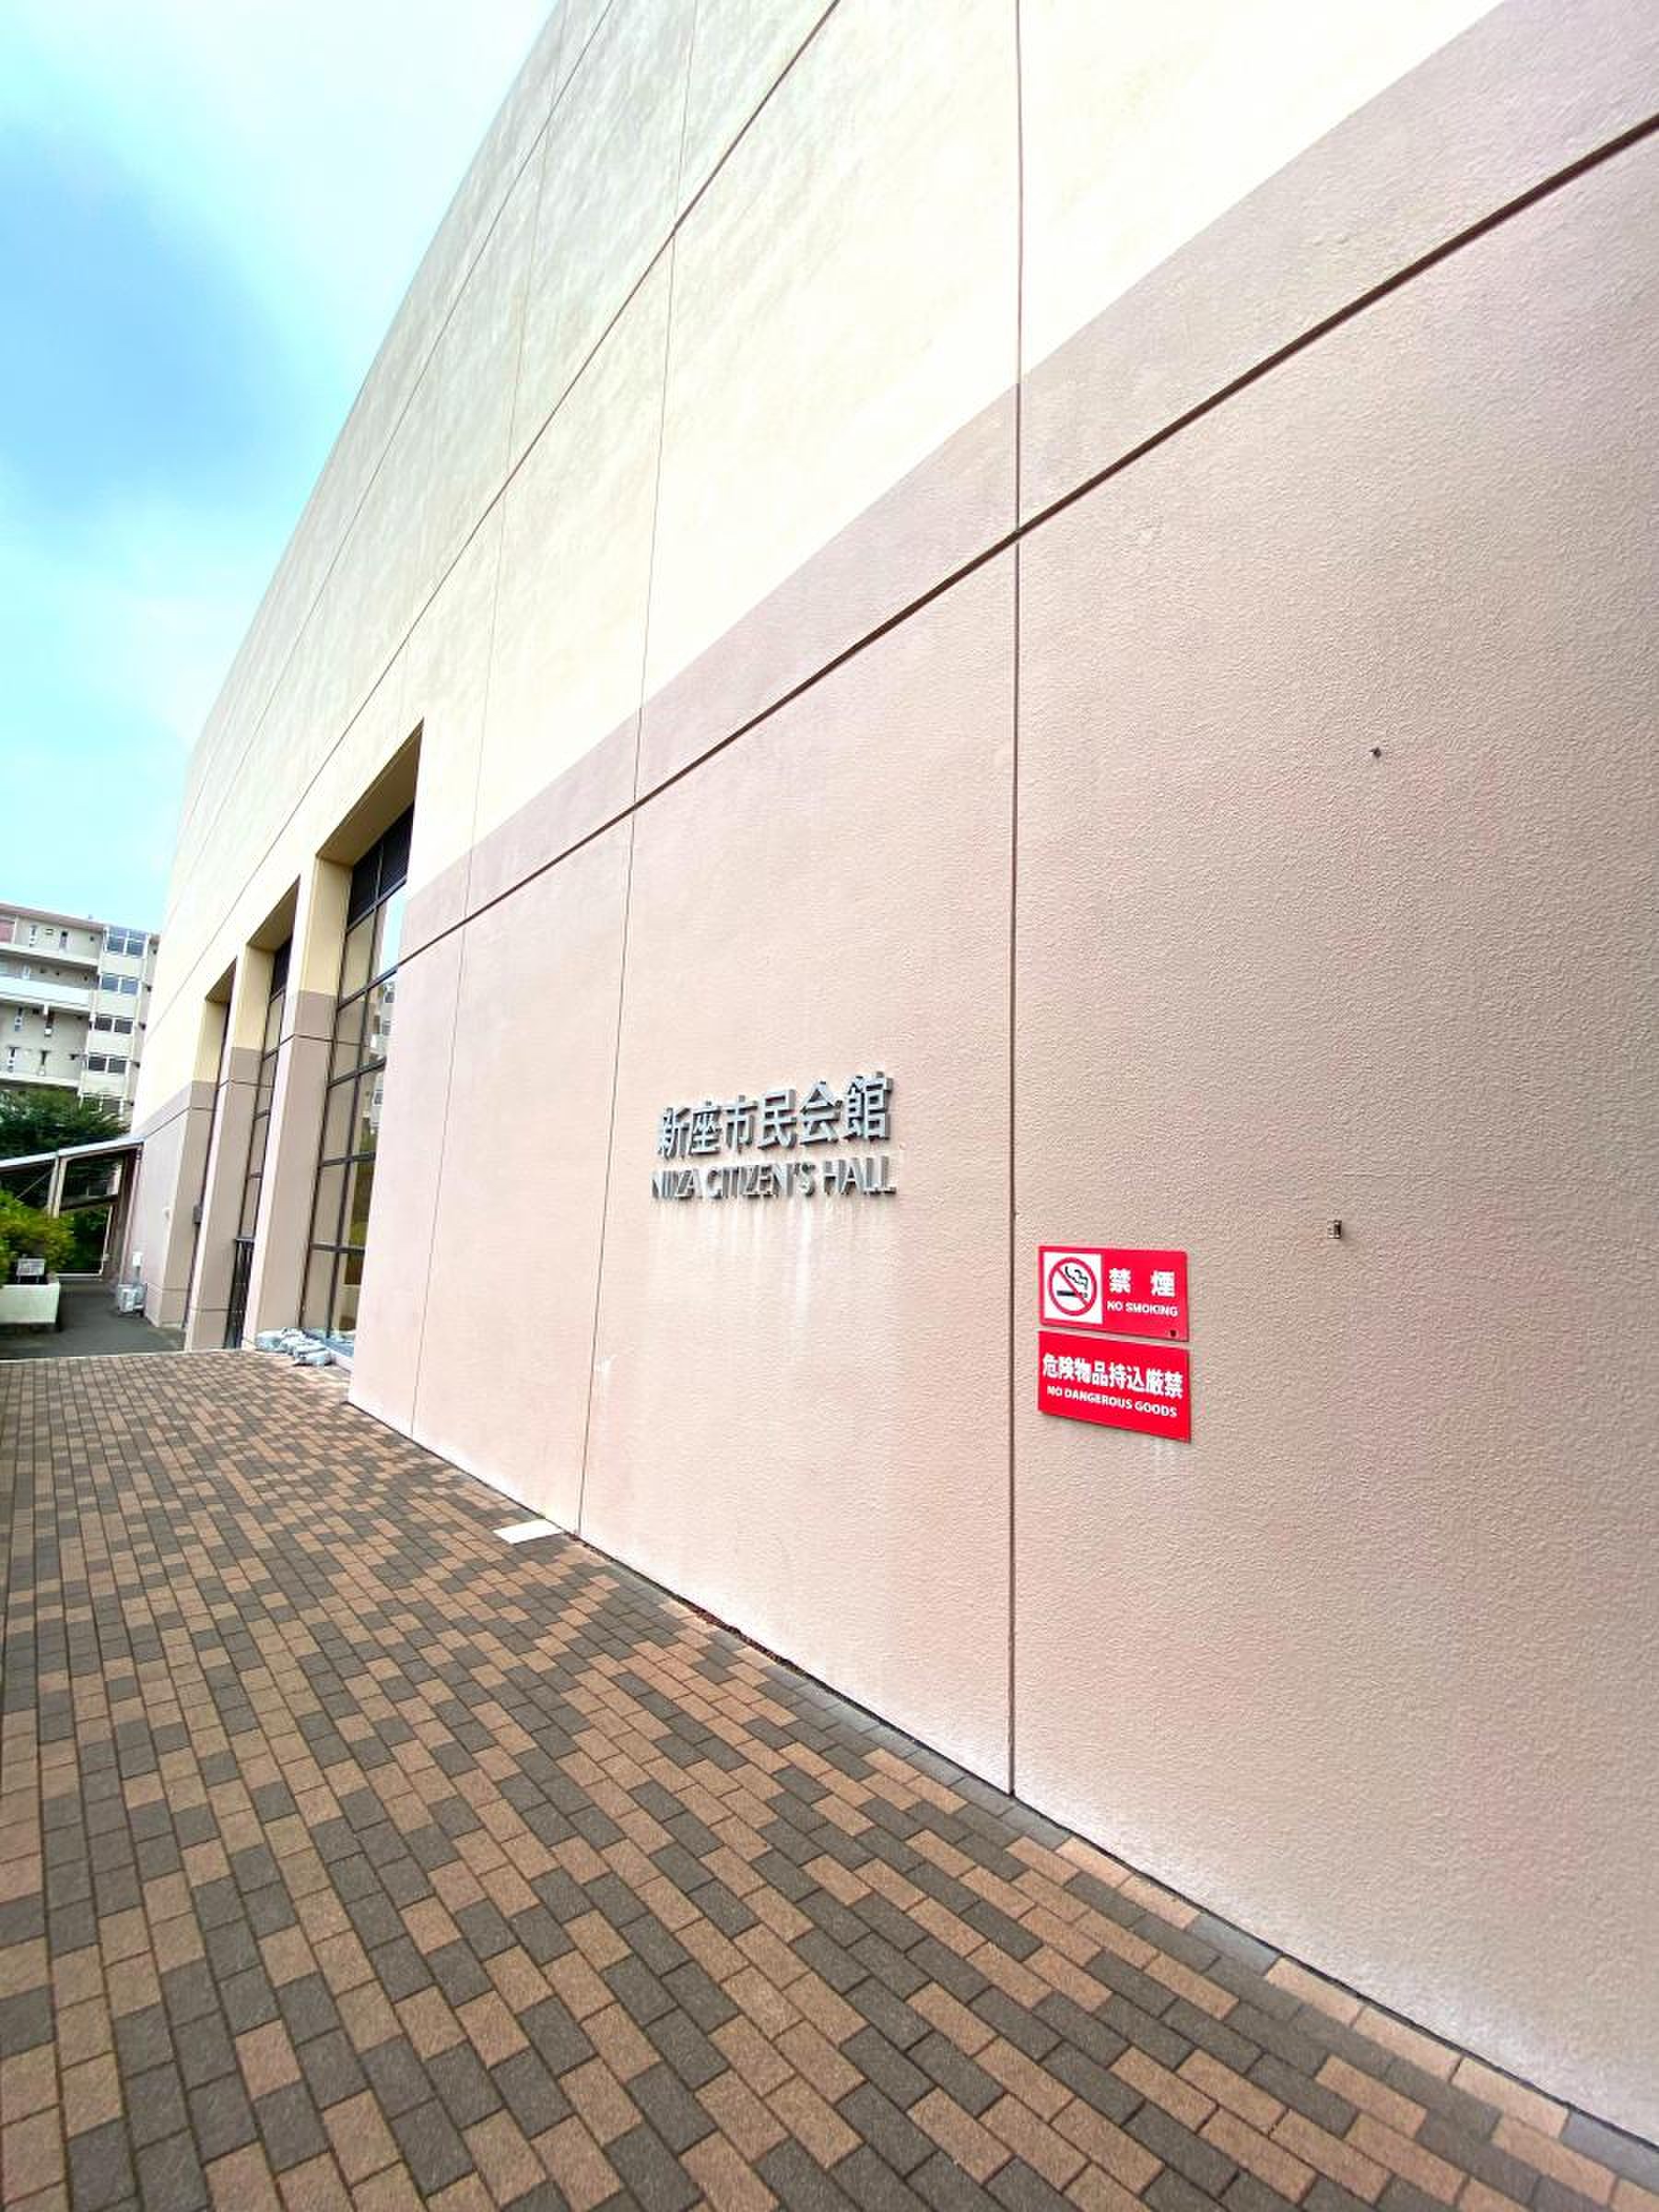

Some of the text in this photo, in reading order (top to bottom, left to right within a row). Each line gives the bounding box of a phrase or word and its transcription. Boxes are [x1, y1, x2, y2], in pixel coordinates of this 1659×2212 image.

[657, 1071, 894, 1159] 新座市民会館
[706, 1161, 816, 1199] CITIZEN'S
[822, 1156, 897, 1195] HALL
[1107, 1300, 1179, 1317] NO SMOKING
[1042, 1352, 1183, 1399] 危険物品持込厳禁
[1047, 1385, 1178, 1418] NO DANGEROUS GOODS
